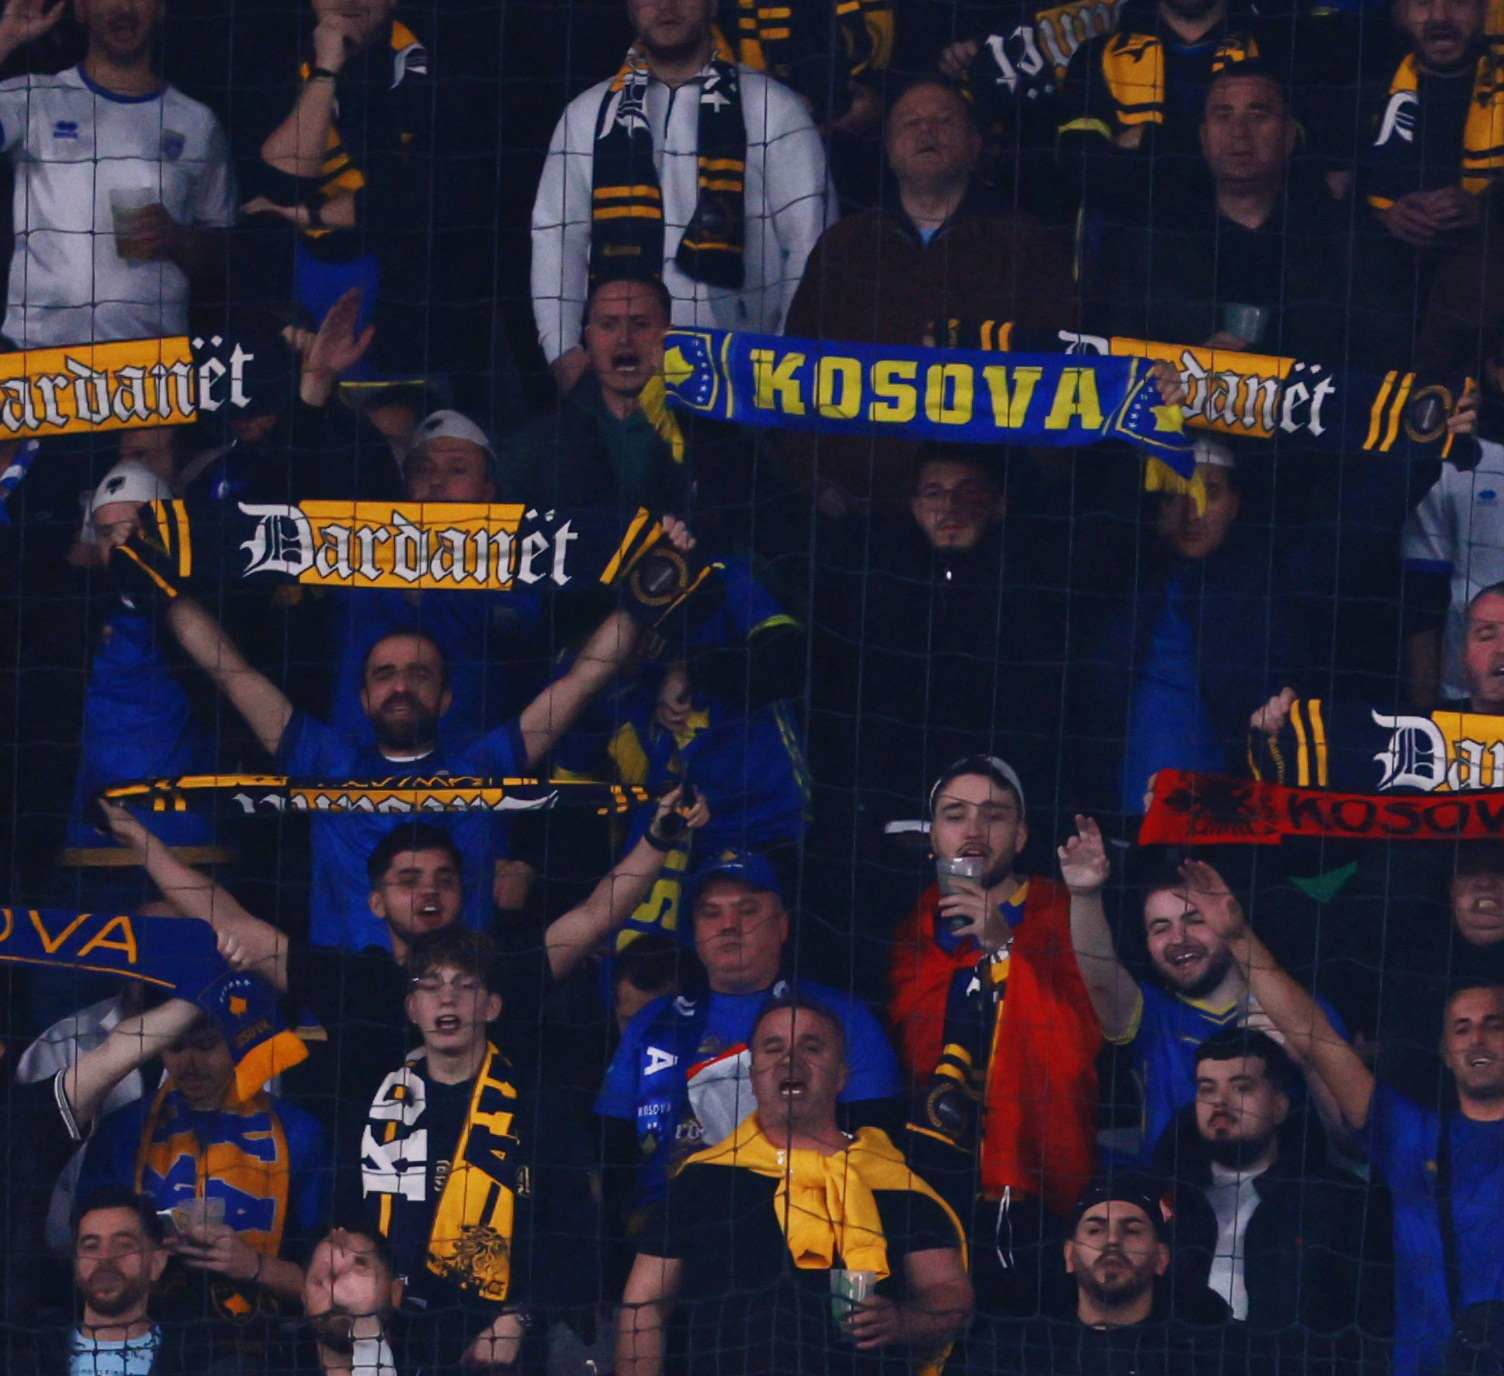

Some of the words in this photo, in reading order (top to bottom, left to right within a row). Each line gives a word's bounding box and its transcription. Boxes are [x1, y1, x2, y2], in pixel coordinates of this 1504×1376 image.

[0, 334, 255, 434] ardanët
[752, 347, 1104, 432] KOSOVA
[239, 501, 578, 588] Dardanët
